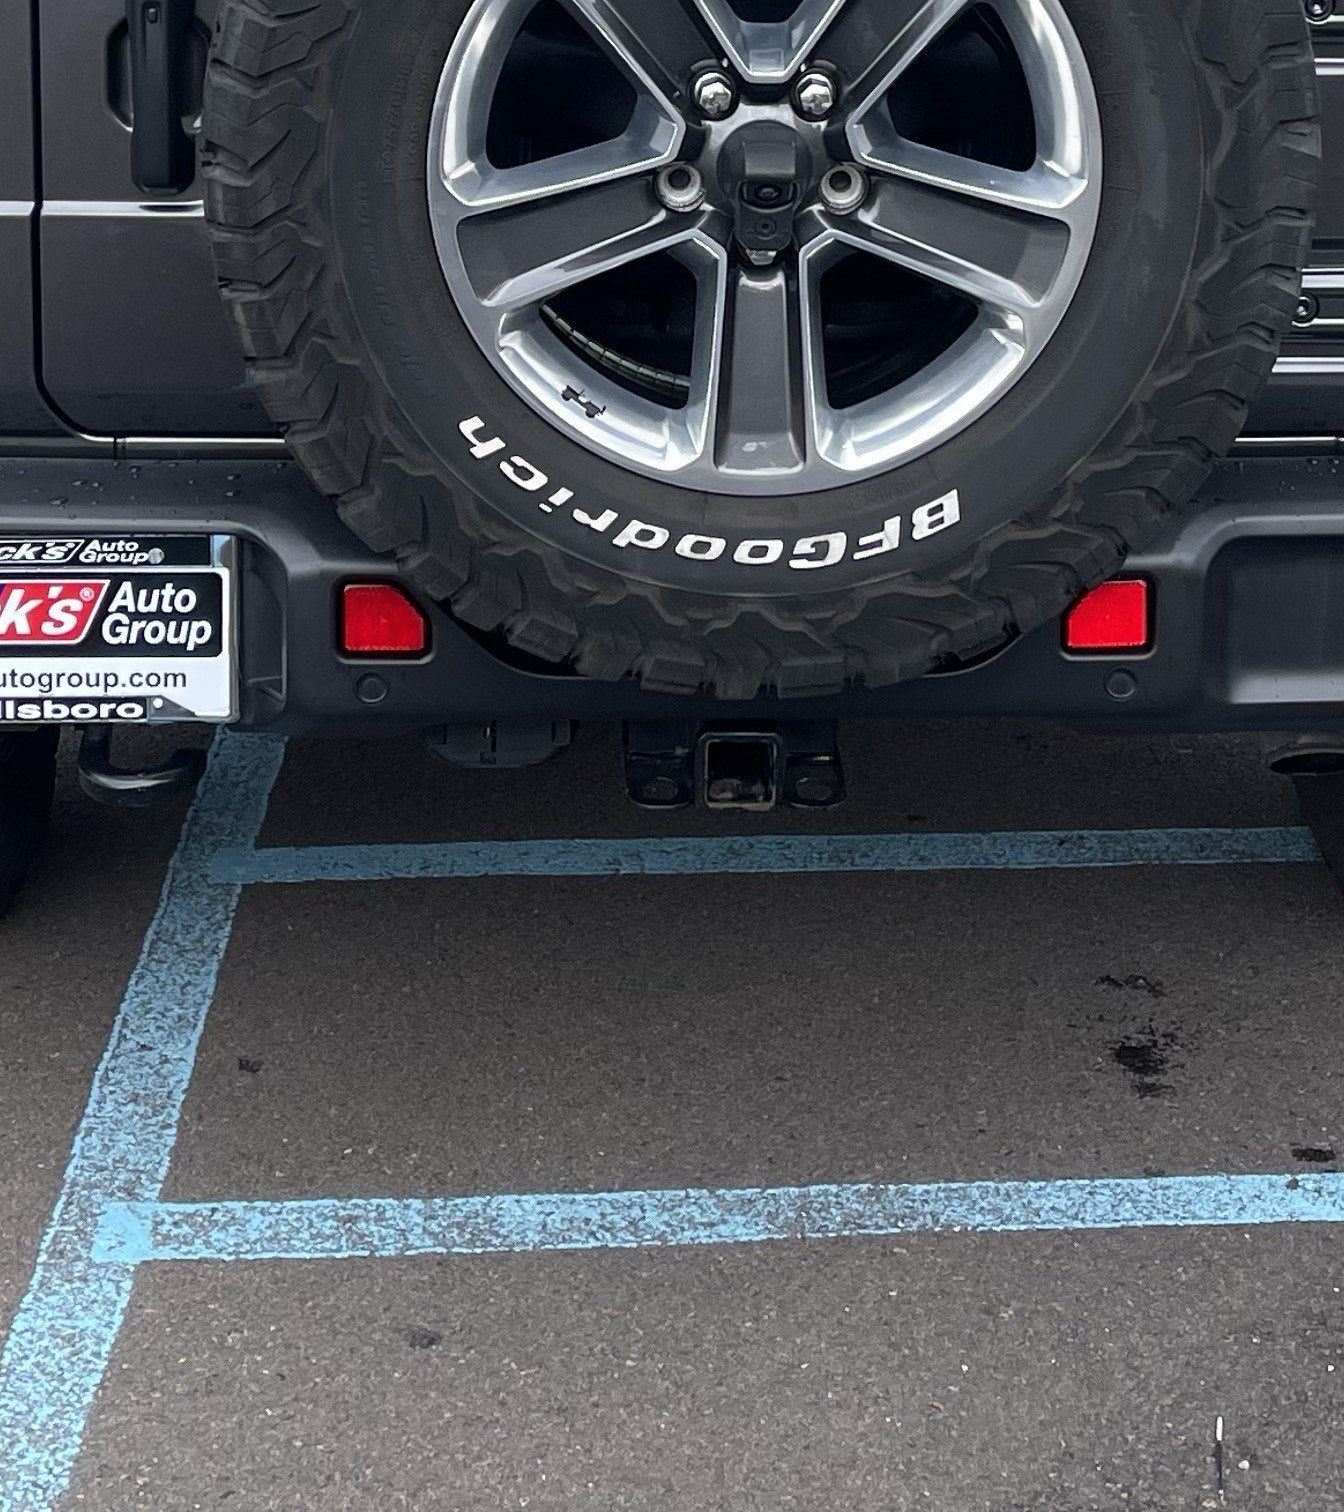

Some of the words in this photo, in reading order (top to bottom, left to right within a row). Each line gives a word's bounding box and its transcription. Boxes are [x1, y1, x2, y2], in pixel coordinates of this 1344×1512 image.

[458, 415, 963, 571] BFGoodrich
[78, 550, 150, 565] Group
[84, 539, 139, 552] Auto
[107, 581, 197, 614] Auto
[101, 614, 213, 651] Group
